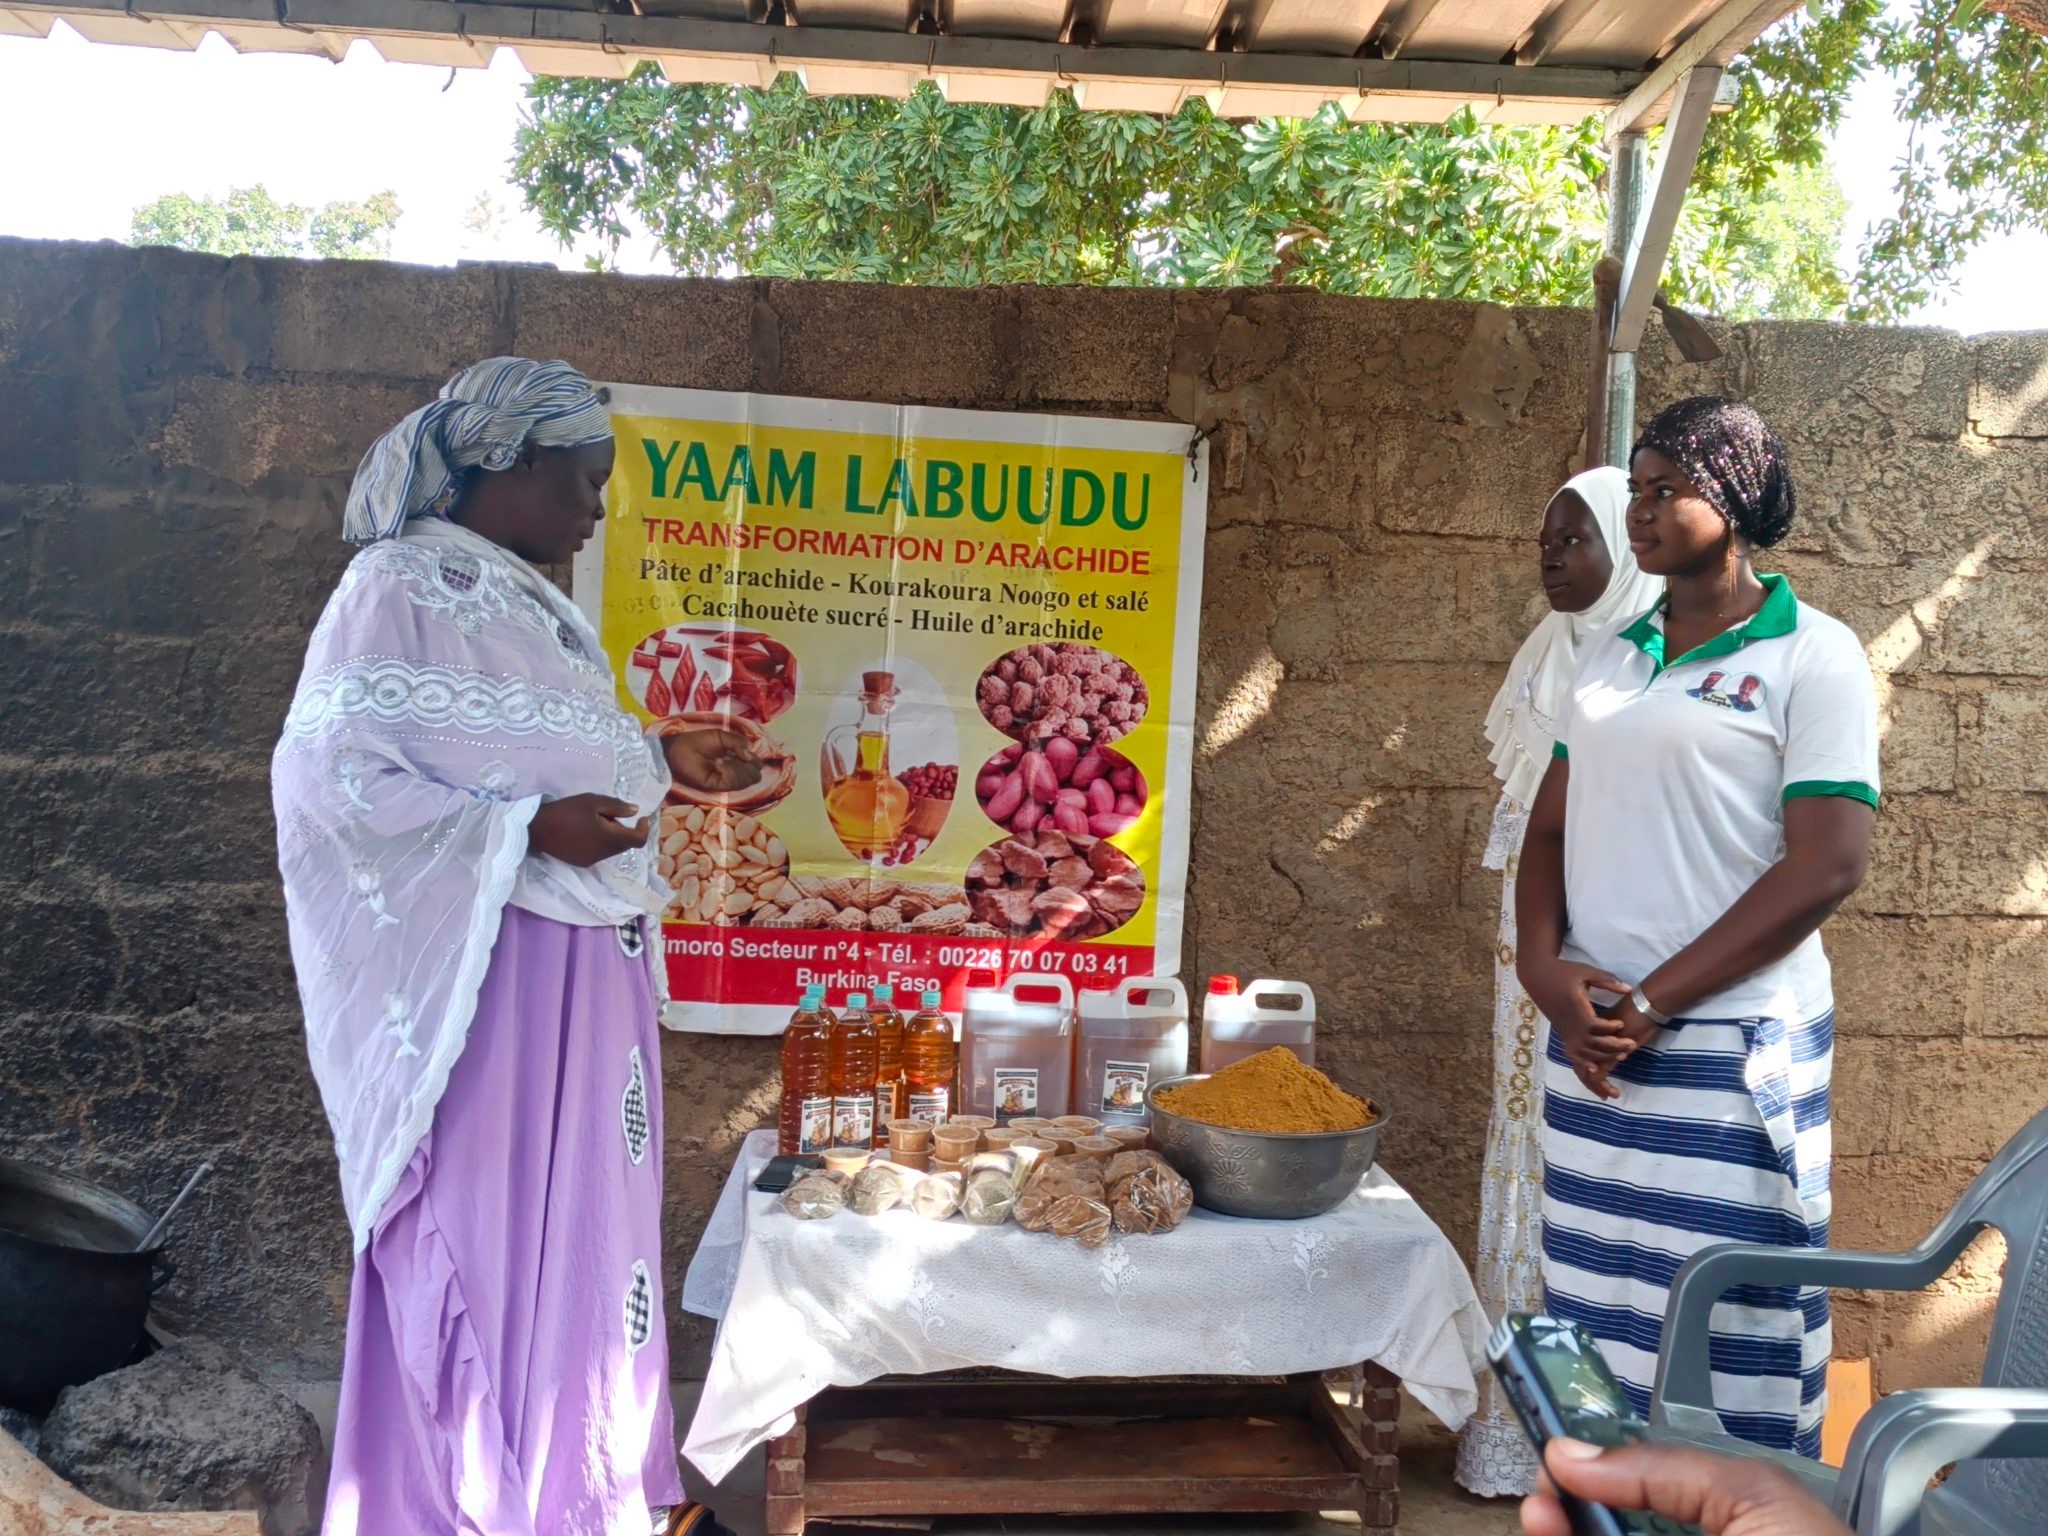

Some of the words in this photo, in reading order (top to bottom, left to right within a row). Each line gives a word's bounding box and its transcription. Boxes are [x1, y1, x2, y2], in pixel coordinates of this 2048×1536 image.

[641, 438, 817, 509] YAAM
[844, 454, 1150, 531] LABUUDU
[642, 517, 943, 563] TRANSFORMATION
[954, 539, 1151, 576] D’ARACHIDE
[639, 558, 692, 583] Pâte
[699, 563, 825, 591] d’arachide
[848, 572, 992, 603] Kourakoura
[1000, 582, 1070, 612] Noogo
[1078, 590, 1100, 609] et
[1105, 590, 1149, 612] salé
[682, 593, 819, 624] Cacahouète
[825, 605, 888, 628] sucré
[911, 608, 974, 634] Huile
[981, 613, 1104, 641] d’arachide
[660, 934, 724, 957] imoro
[730, 937, 820, 960] Secteur
[823, 941, 860, 961] n°4
[878, 942, 917, 964] Tél.
[938, 946, 1002, 969] 00226
[1008, 949, 1034, 970] 70
[1039, 951, 1066, 971] 07
[1071, 952, 1098, 973] 03
[1103, 955, 1128, 974] 41
[796, 967, 879, 990] Burkina
[887, 971, 941, 993] Faso
